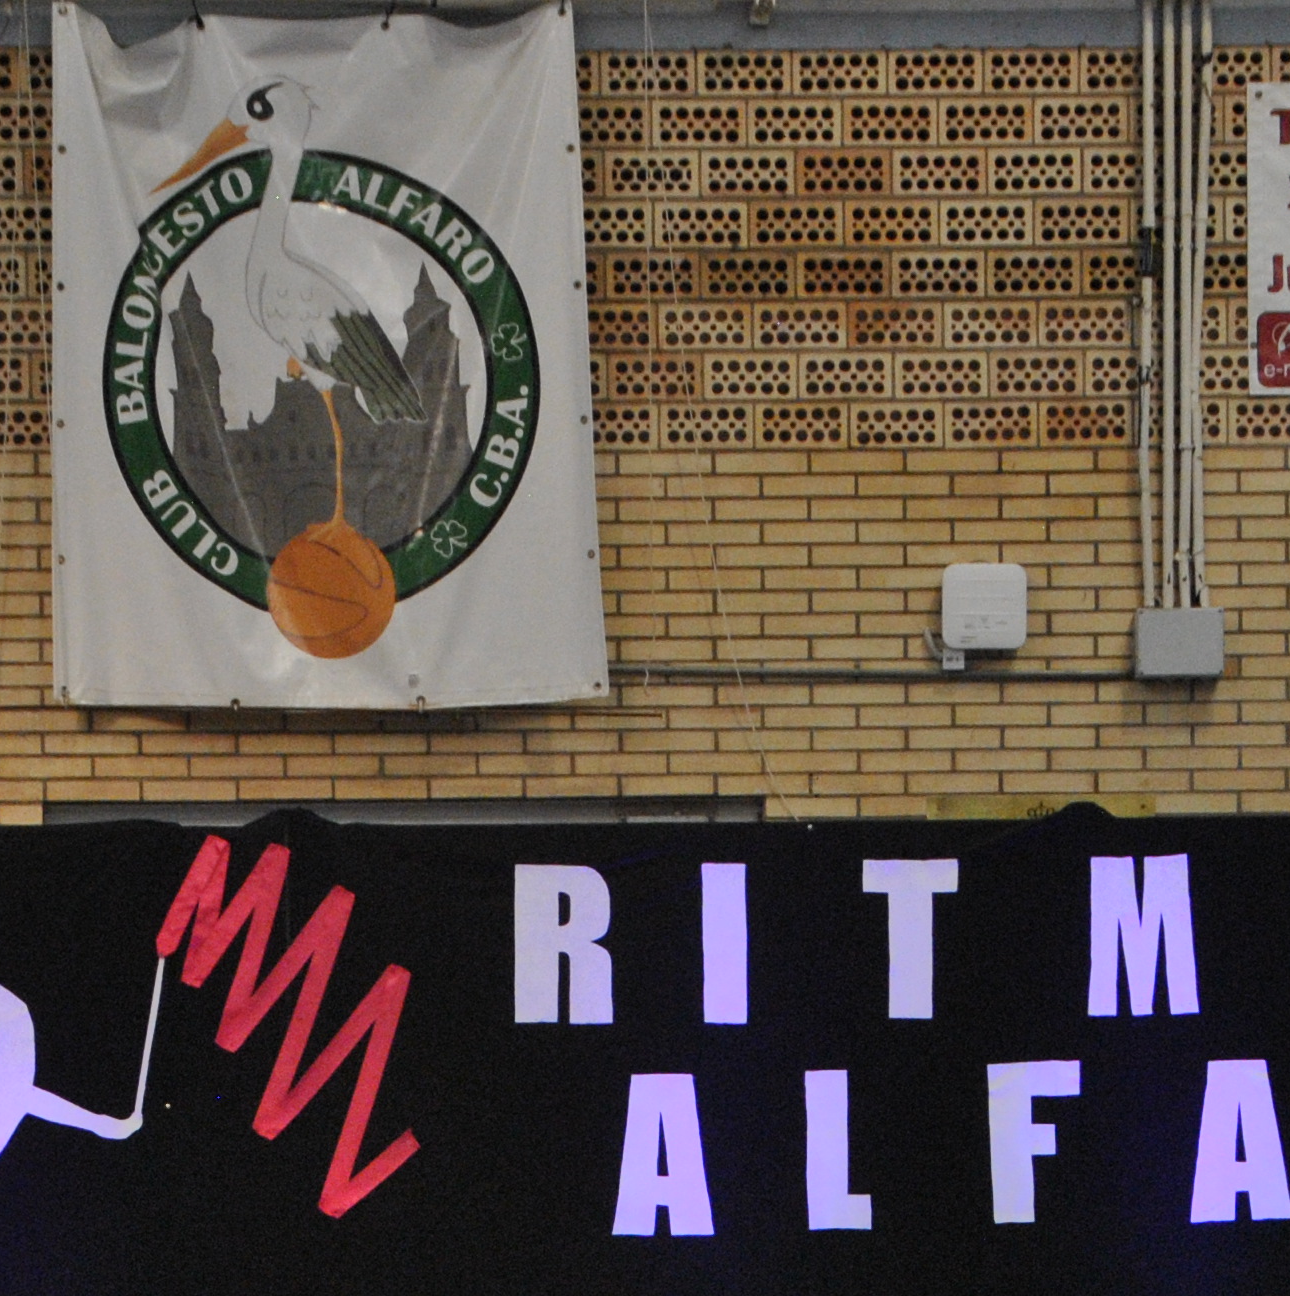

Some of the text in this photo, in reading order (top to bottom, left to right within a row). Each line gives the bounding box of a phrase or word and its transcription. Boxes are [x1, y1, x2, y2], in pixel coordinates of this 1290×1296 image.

[143, 469, 240, 576] CLUB
[332, 164, 496, 284] ALFARO
[468, 384, 529, 508] C.B.A.
